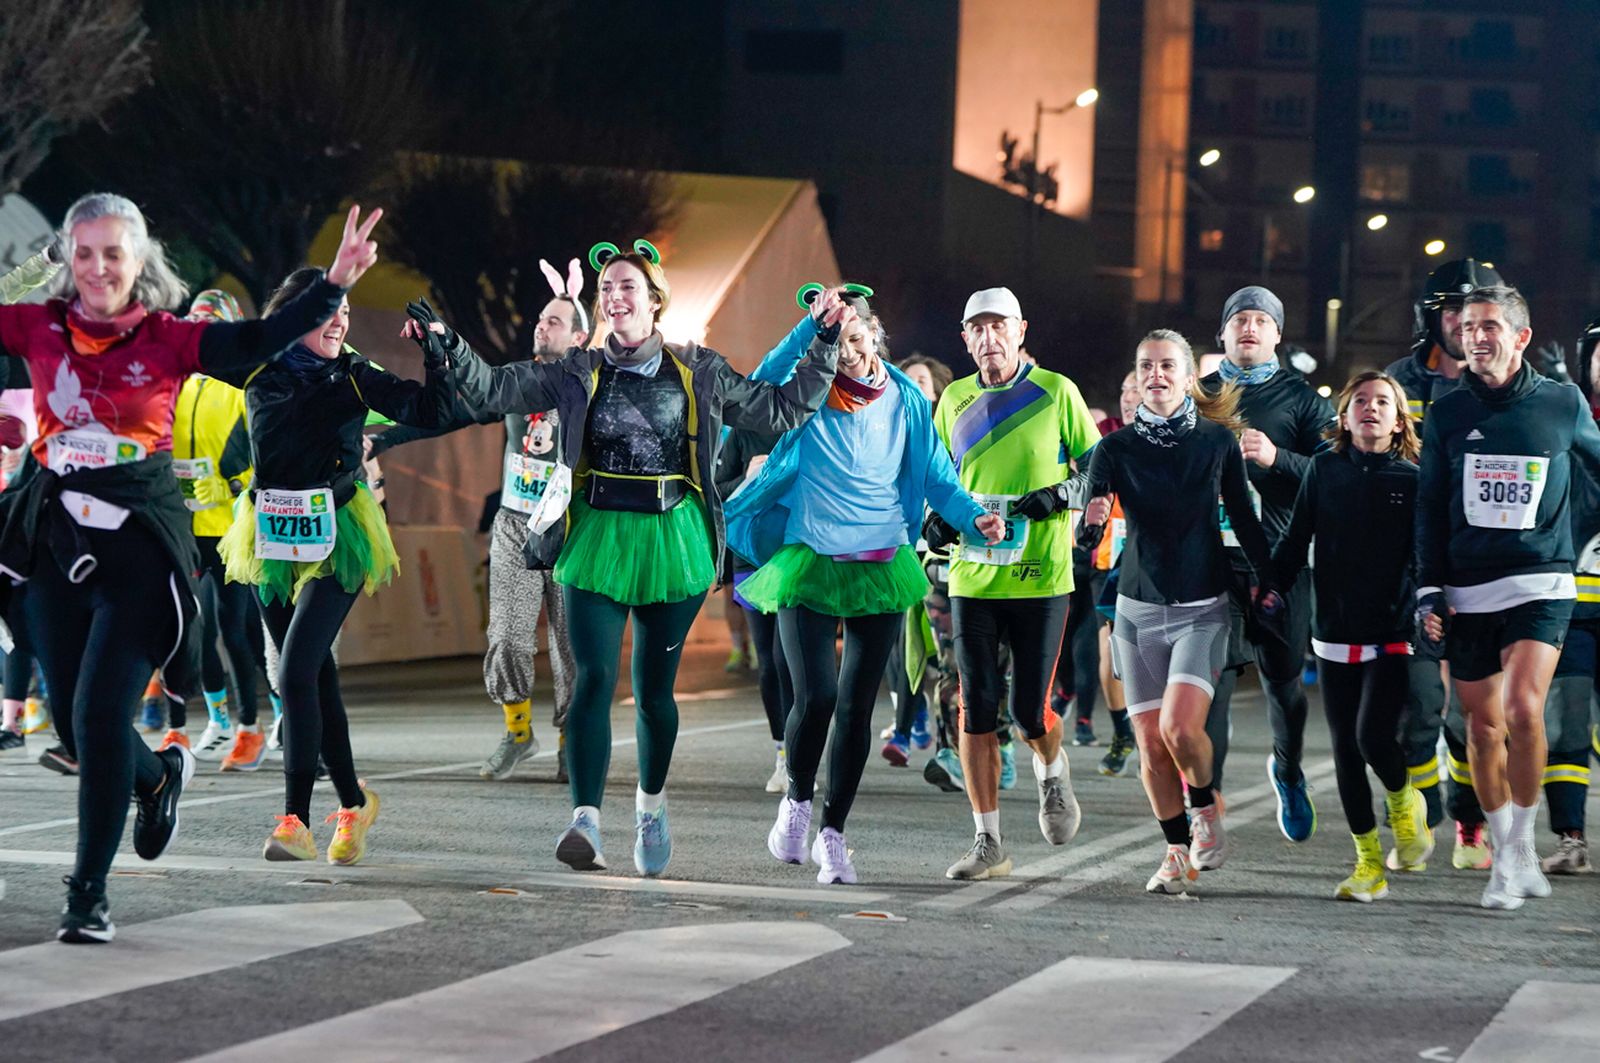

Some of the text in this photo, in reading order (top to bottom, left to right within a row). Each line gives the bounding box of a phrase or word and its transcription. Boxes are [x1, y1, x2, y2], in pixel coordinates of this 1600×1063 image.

[514, 475, 548, 497] 4942
[1480, 480, 1532, 504] 3083
[263, 504, 277, 513] SAN
[271, 498, 303, 507] NOCHE DE
[267, 515, 322, 537] 12781
